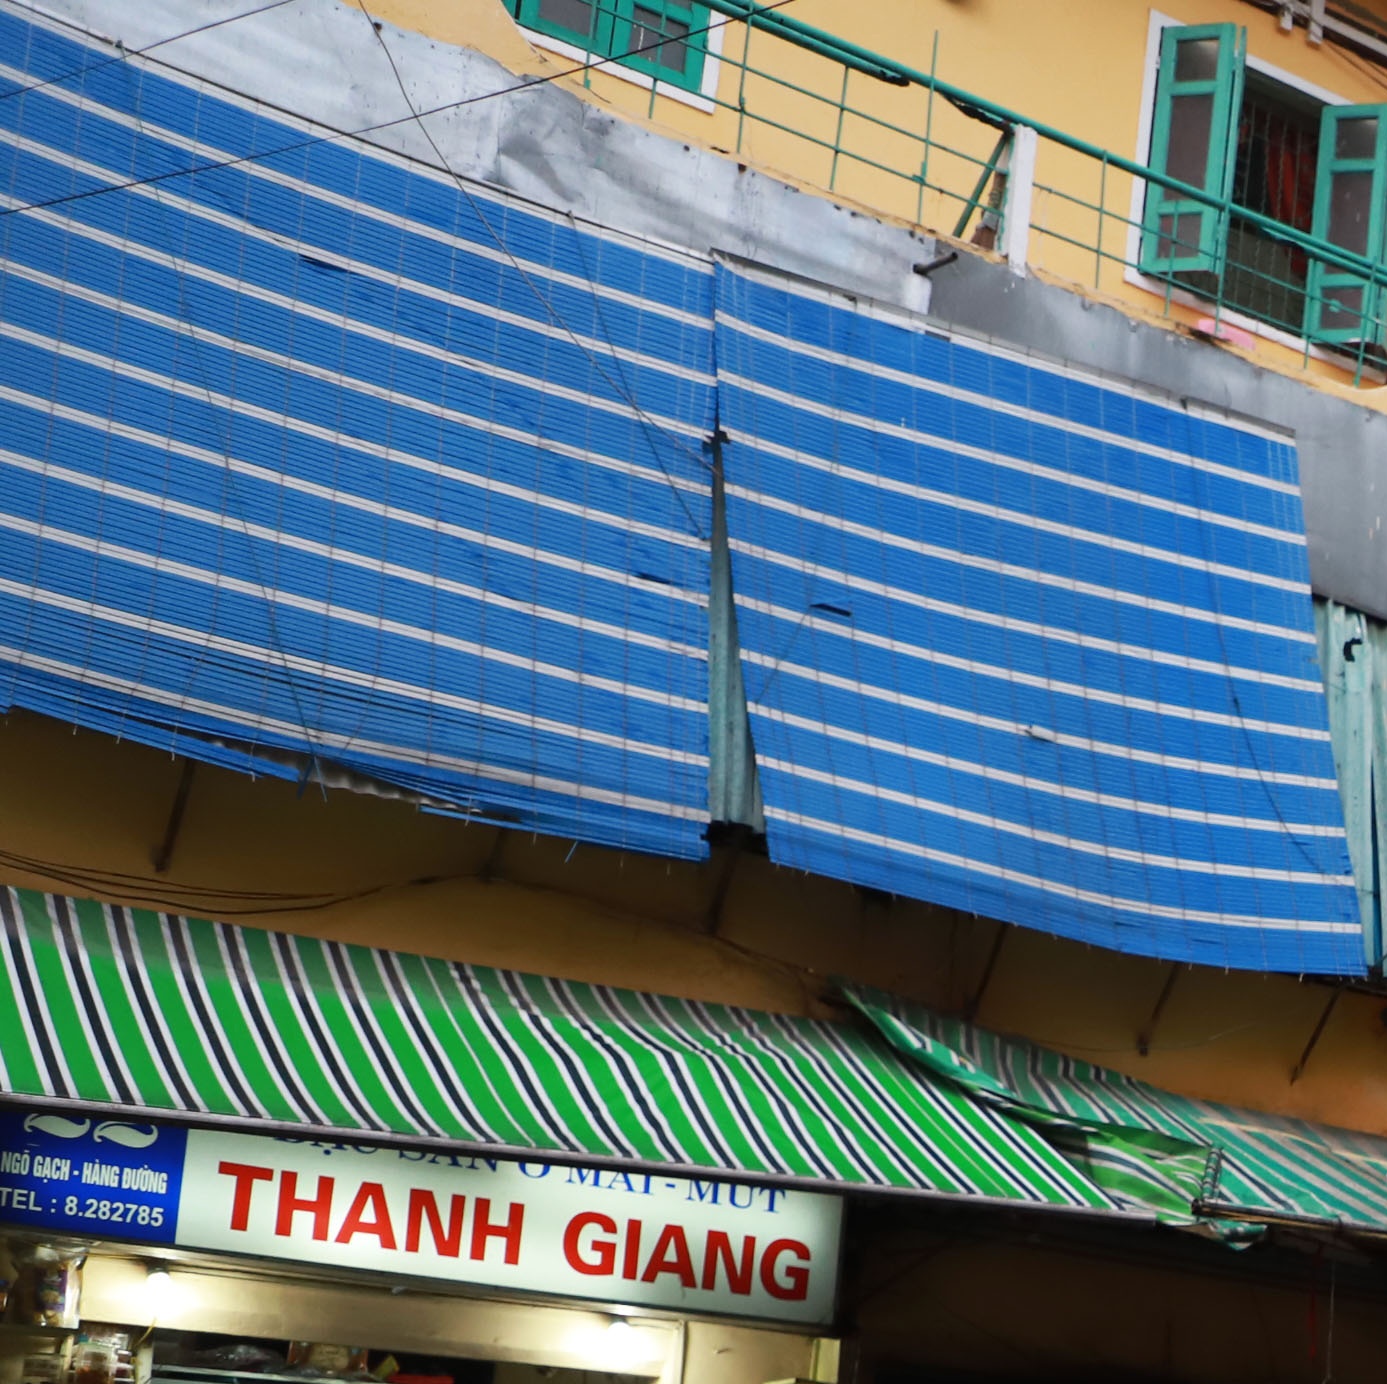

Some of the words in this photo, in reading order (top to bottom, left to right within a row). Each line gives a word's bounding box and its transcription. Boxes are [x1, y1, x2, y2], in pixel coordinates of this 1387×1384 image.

[1, 1150, 30, 1175] NGÕ
[33, 1154, 71, 1182] GẠCH
[82, 1159, 119, 1187] HÀNG
[122, 1164, 168, 1194] ĐƯỜNG
[64, 1196, 164, 1227] 8.282785
[218, 1161, 525, 1265] THANH
[563, 1211, 811, 1300] GIANG
